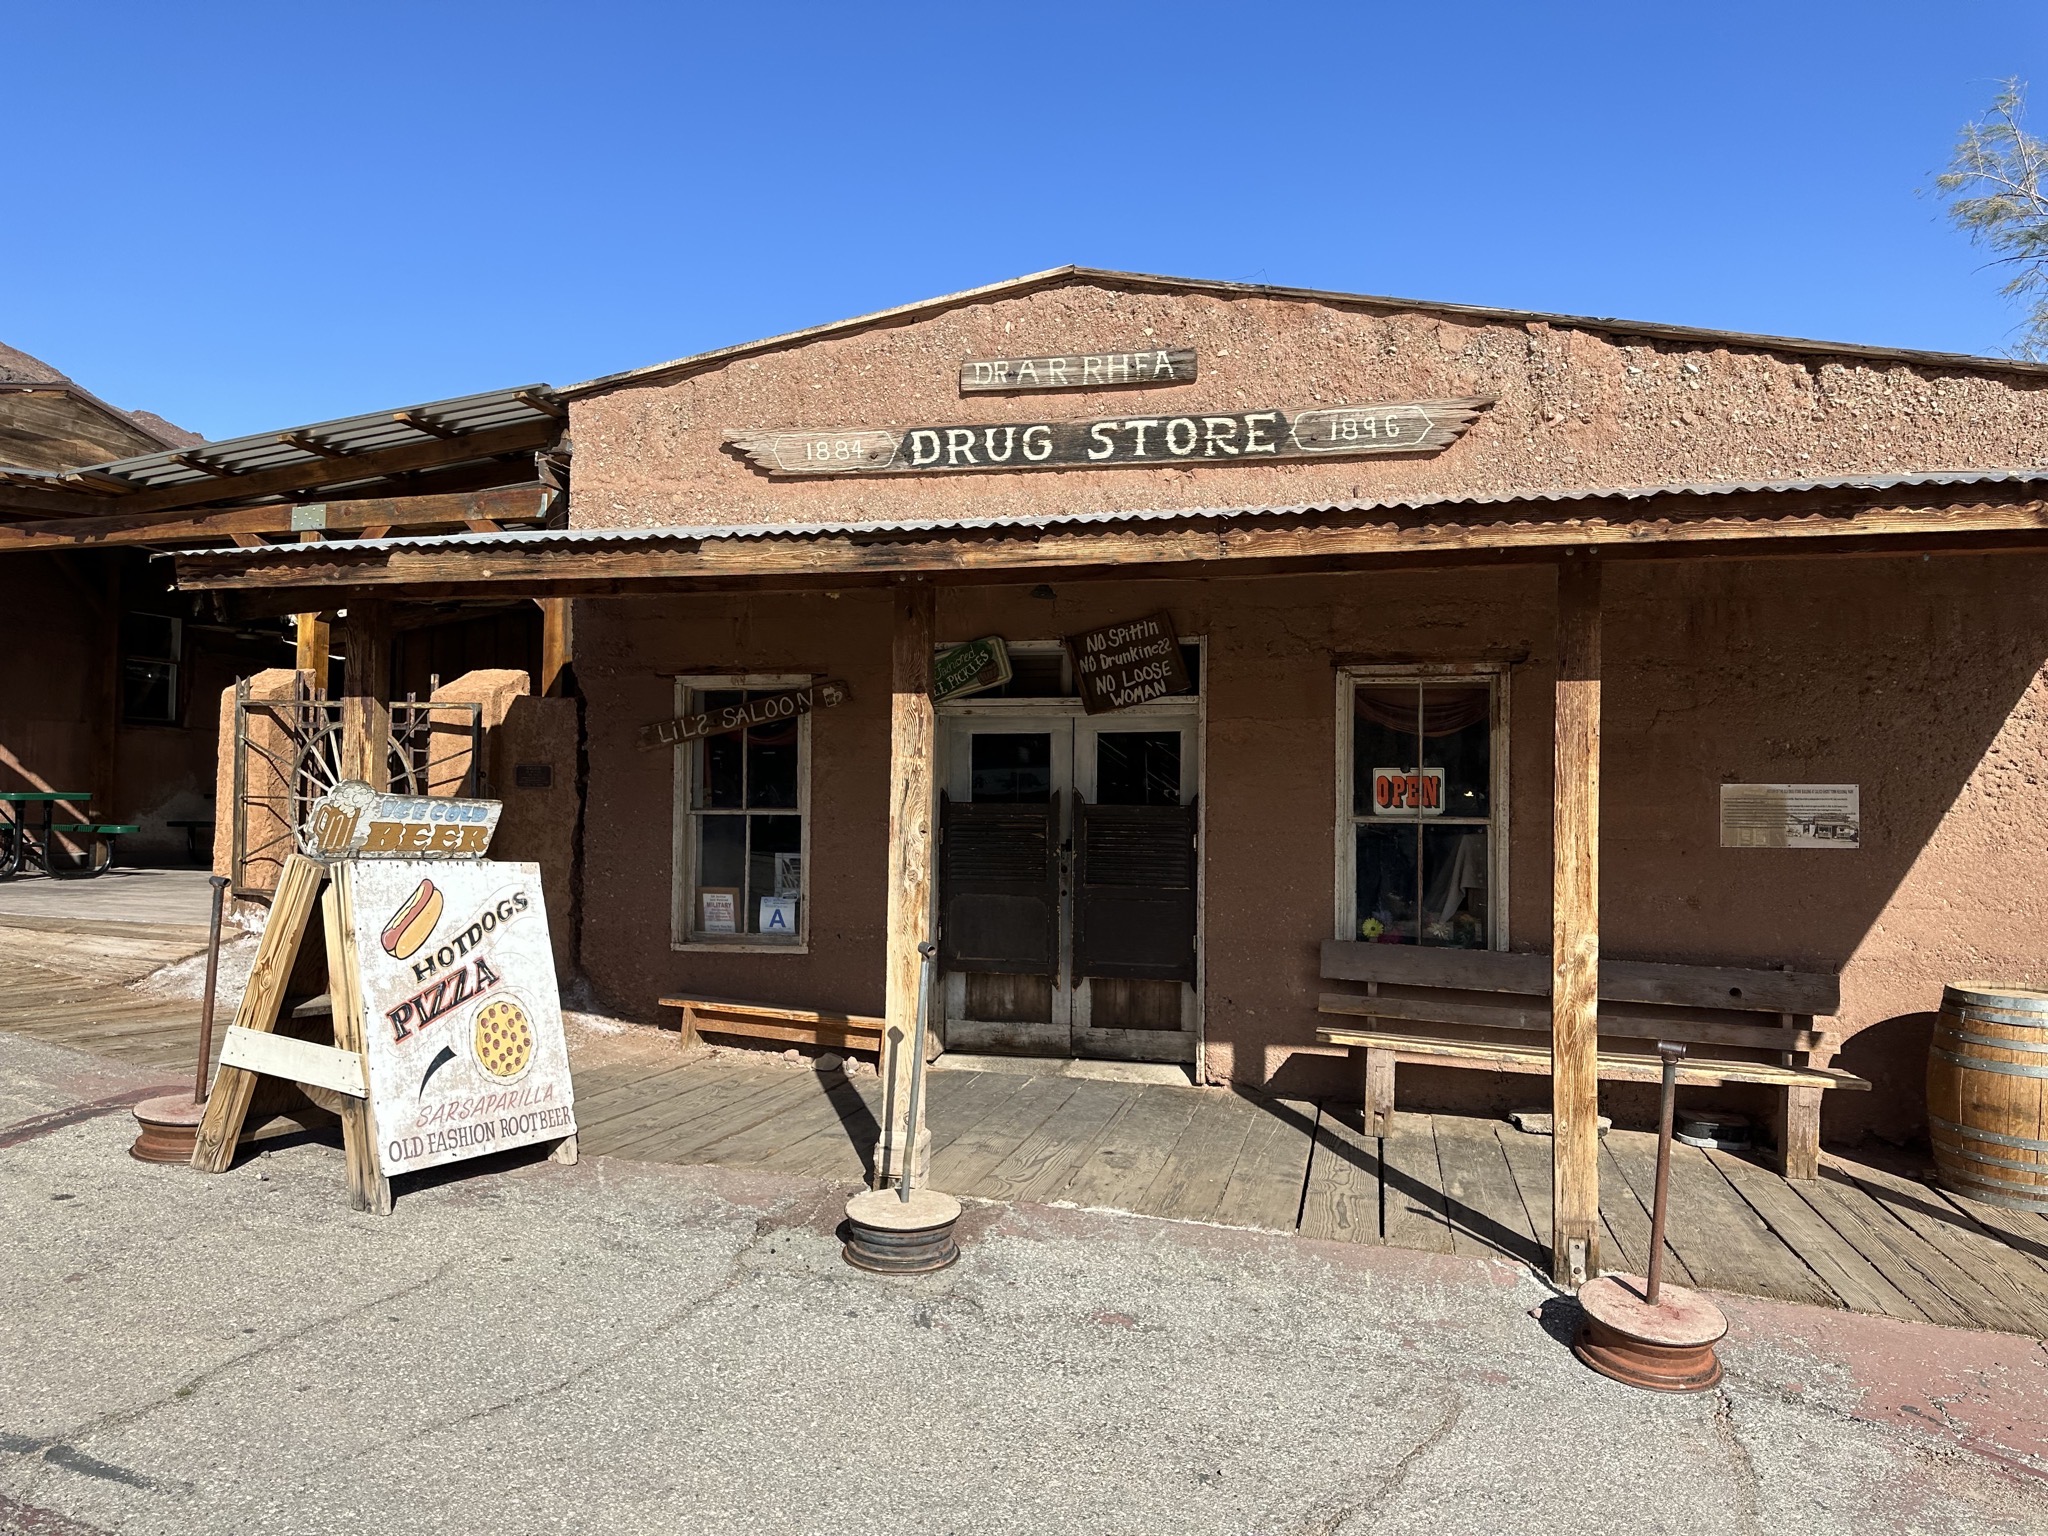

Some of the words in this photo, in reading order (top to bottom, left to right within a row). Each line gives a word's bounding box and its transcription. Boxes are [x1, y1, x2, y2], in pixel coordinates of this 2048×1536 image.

[806, 439, 865, 461] 1884
[910, 425, 1055, 467] DRUG
[1087, 410, 1277, 462] STORE
[1330, 414, 1400, 441] 1896
[1086, 633, 1107, 653] NO
[946, 649, 989, 690] PICKLES
[1080, 655, 1097, 674] NO
[1096, 674, 1116, 695] NO
[1121, 660, 1172, 688] LOOSE
[722, 688, 814, 729] SALOON
[1109, 678, 1167, 706] WOMAN
[1376, 775, 1441, 809] OPEN
[381, 800, 431, 821] ICE
[430, 803, 488, 823] COLD
[360, 821, 487, 852] BEER
[706, 901, 732, 909] MILITARY
[768, 908, 786, 928] A
[411, 890, 529, 985] HOTDOGS
[386, 956, 500, 1044] PIZZA
[415, 1082, 555, 1129] SARSAPARILLA
[387, 1133, 425, 1163] OLD
[427, 1120, 496, 1156] FASHION
